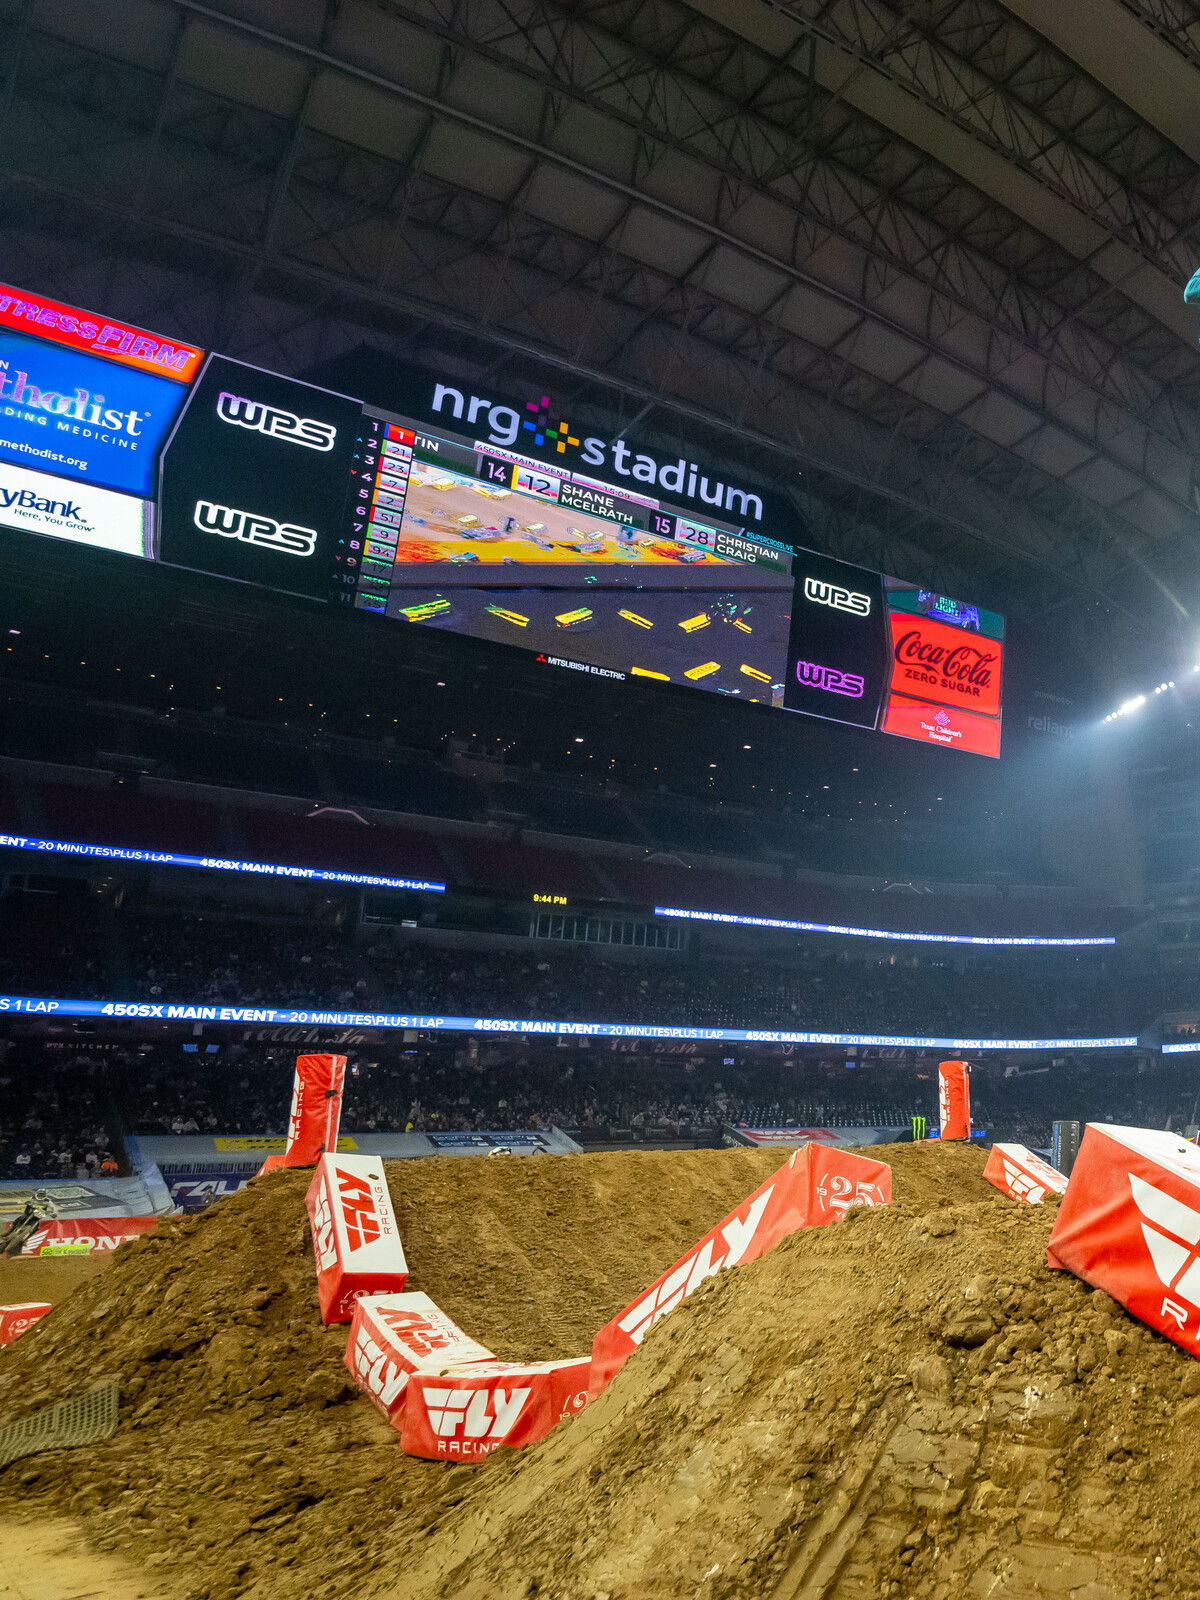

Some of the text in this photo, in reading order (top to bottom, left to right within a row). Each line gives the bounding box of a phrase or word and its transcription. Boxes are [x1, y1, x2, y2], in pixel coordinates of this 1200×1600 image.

[0, 408, 138, 450] DING MEDICINE
[217, 392, 336, 451] WPS
[372, 422, 404, 440] 1 1
[0, 439, 88, 471] methodist.org
[367, 439, 406, 456] 2 21
[432, 383, 763, 520] nrg stadium
[365, 455, 404, 474] 3 23
[510, 454, 535, 468] MAIN
[538, 462, 568, 479] EVENT
[362, 472, 398, 489] 4 7
[488, 462, 552, 496] 14 12
[359, 489, 394, 506] 5 2
[562, 484, 614, 508] SHANE
[14, 508, 92, 533] Here, You Grow
[356, 506, 394, 523] 6 51
[561, 495, 633, 524] MCELRATH
[194, 500, 317, 556] WPS
[353, 522, 389, 540] 7 9
[655, 516, 709, 545] 15 28
[350, 540, 390, 557] 8 94
[717, 545, 756, 563] CRAIG
[718, 534, 779, 560] CHRISTIAN
[805, 577, 871, 617] WPS
[548, 656, 625, 680] MITSUBISHI ELECTRIC
[797, 661, 865, 698] WPS
[905, 669, 980, 697] ZERO SUGAR
[0, 836, 27, 847] ENT
[38, 841, 54, 850] 20
[152, 854, 173, 862] LAP
[200, 858, 239, 870] 450SX
[242, 863, 274, 874] MAIN
[277, 866, 314, 878] EVENT
[323, 871, 336, 880] 20
[412, 882, 429, 890] LAP
[533, 894, 567, 905] 9:44 PM
[26, 1001, 59, 1012] LAP
[102, 1003, 162, 1018] 450SX
[167, 1006, 215, 1020] MAIN
[220, 1008, 277, 1022] EVENT
[289, 1012, 307, 1022] 20
[420, 1017, 444, 1028] LAP
[474, 1019, 518, 1031] 450SX
[521, 1022, 556, 1033] MAIN
[559, 1023, 600, 1035] EVENT
[609, 1026, 623, 1035] 20
[705, 1030, 723, 1039] LAP
[294, 1080, 305, 1140] RACING
[1002, 1158, 1045, 1204] FL
[335, 1167, 381, 1252] FLY
[375, 1186, 392, 1235] RACING
[47, 1235, 140, 1250] HON
[617, 1183, 776, 1345] FLY
[355, 1324, 410, 1405] FLY
[422, 1387, 532, 1438] FLY
